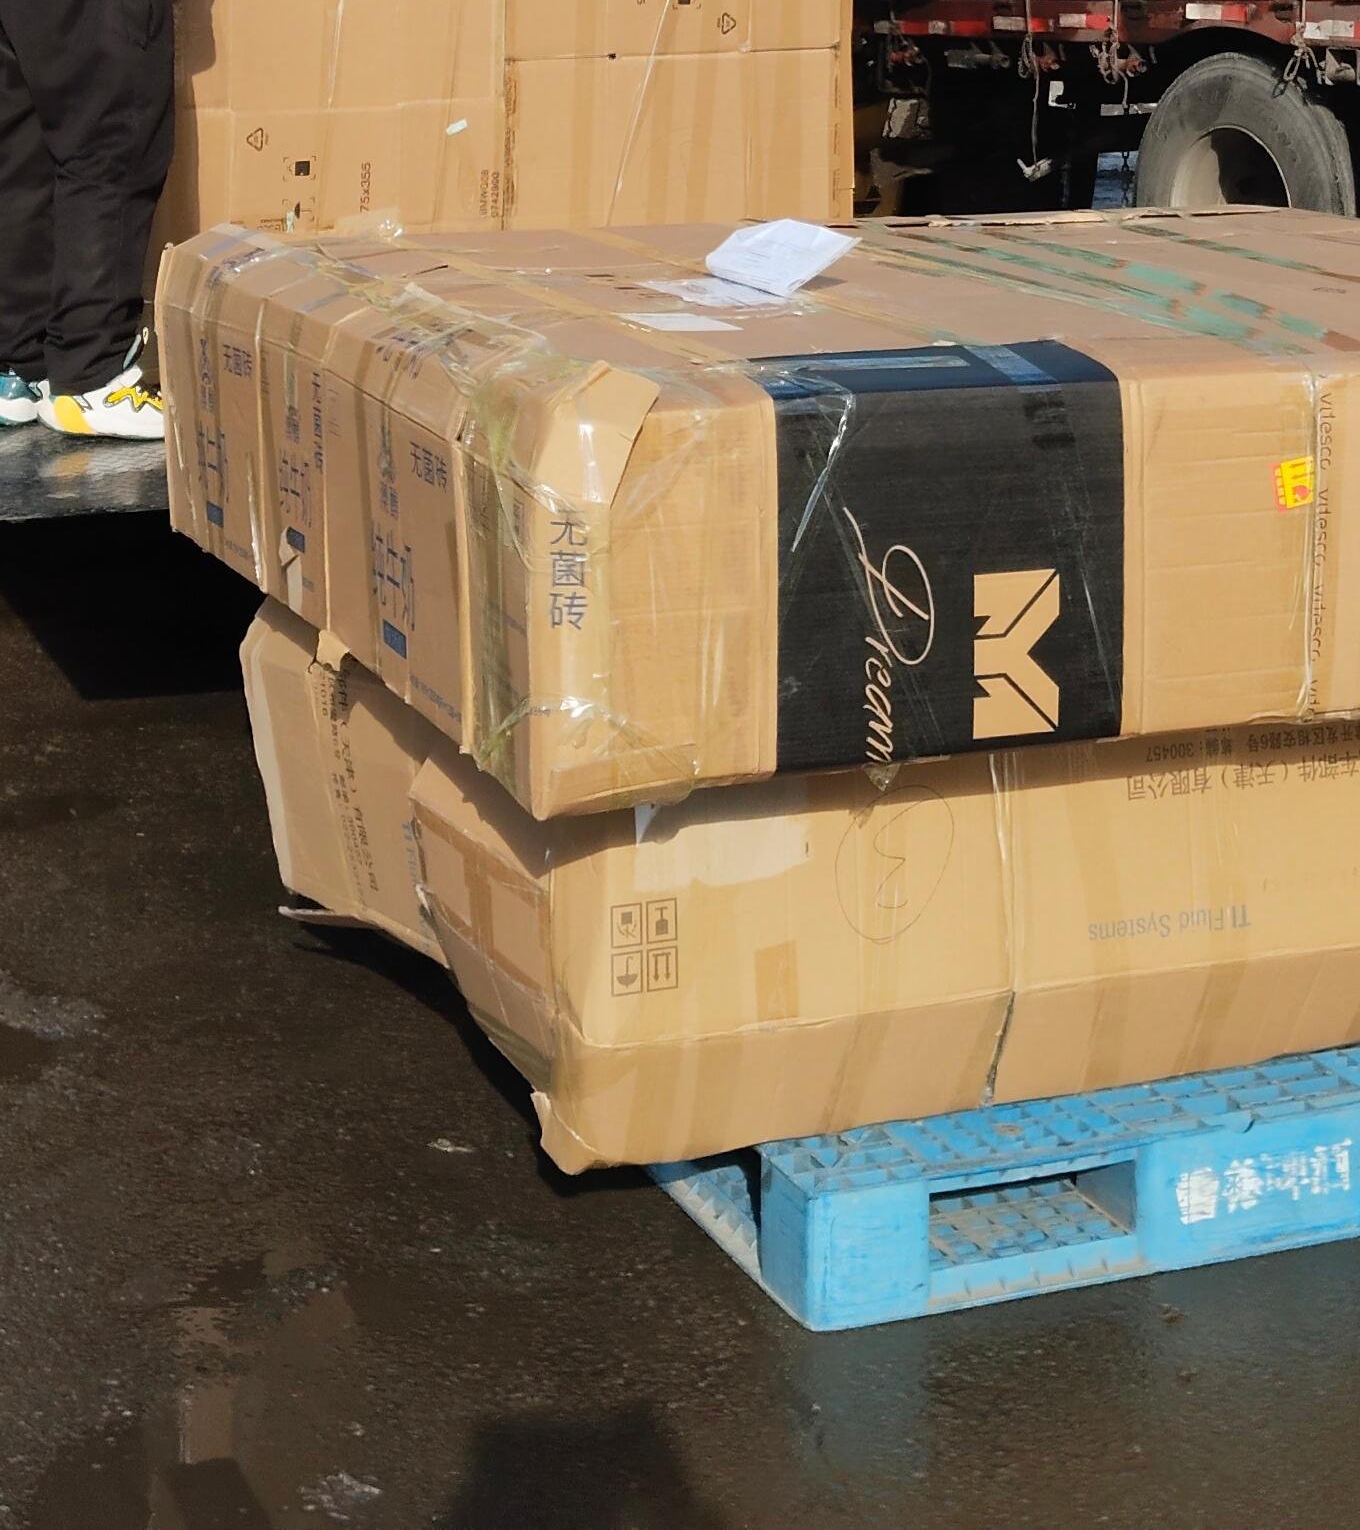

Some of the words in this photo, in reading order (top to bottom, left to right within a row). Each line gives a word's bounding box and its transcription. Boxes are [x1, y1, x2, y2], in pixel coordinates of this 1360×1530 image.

[1319, 392, 1335, 471] vitesco
[409, 440, 448, 494] 无菌砖
[548, 508, 589, 633] 无菌砖
[842, 506, 936, 766] Dream
[1087, 910, 1171, 942] Systems
[1178, 905, 1225, 933] Fluid
[1231, 904, 1252, 929] TI
